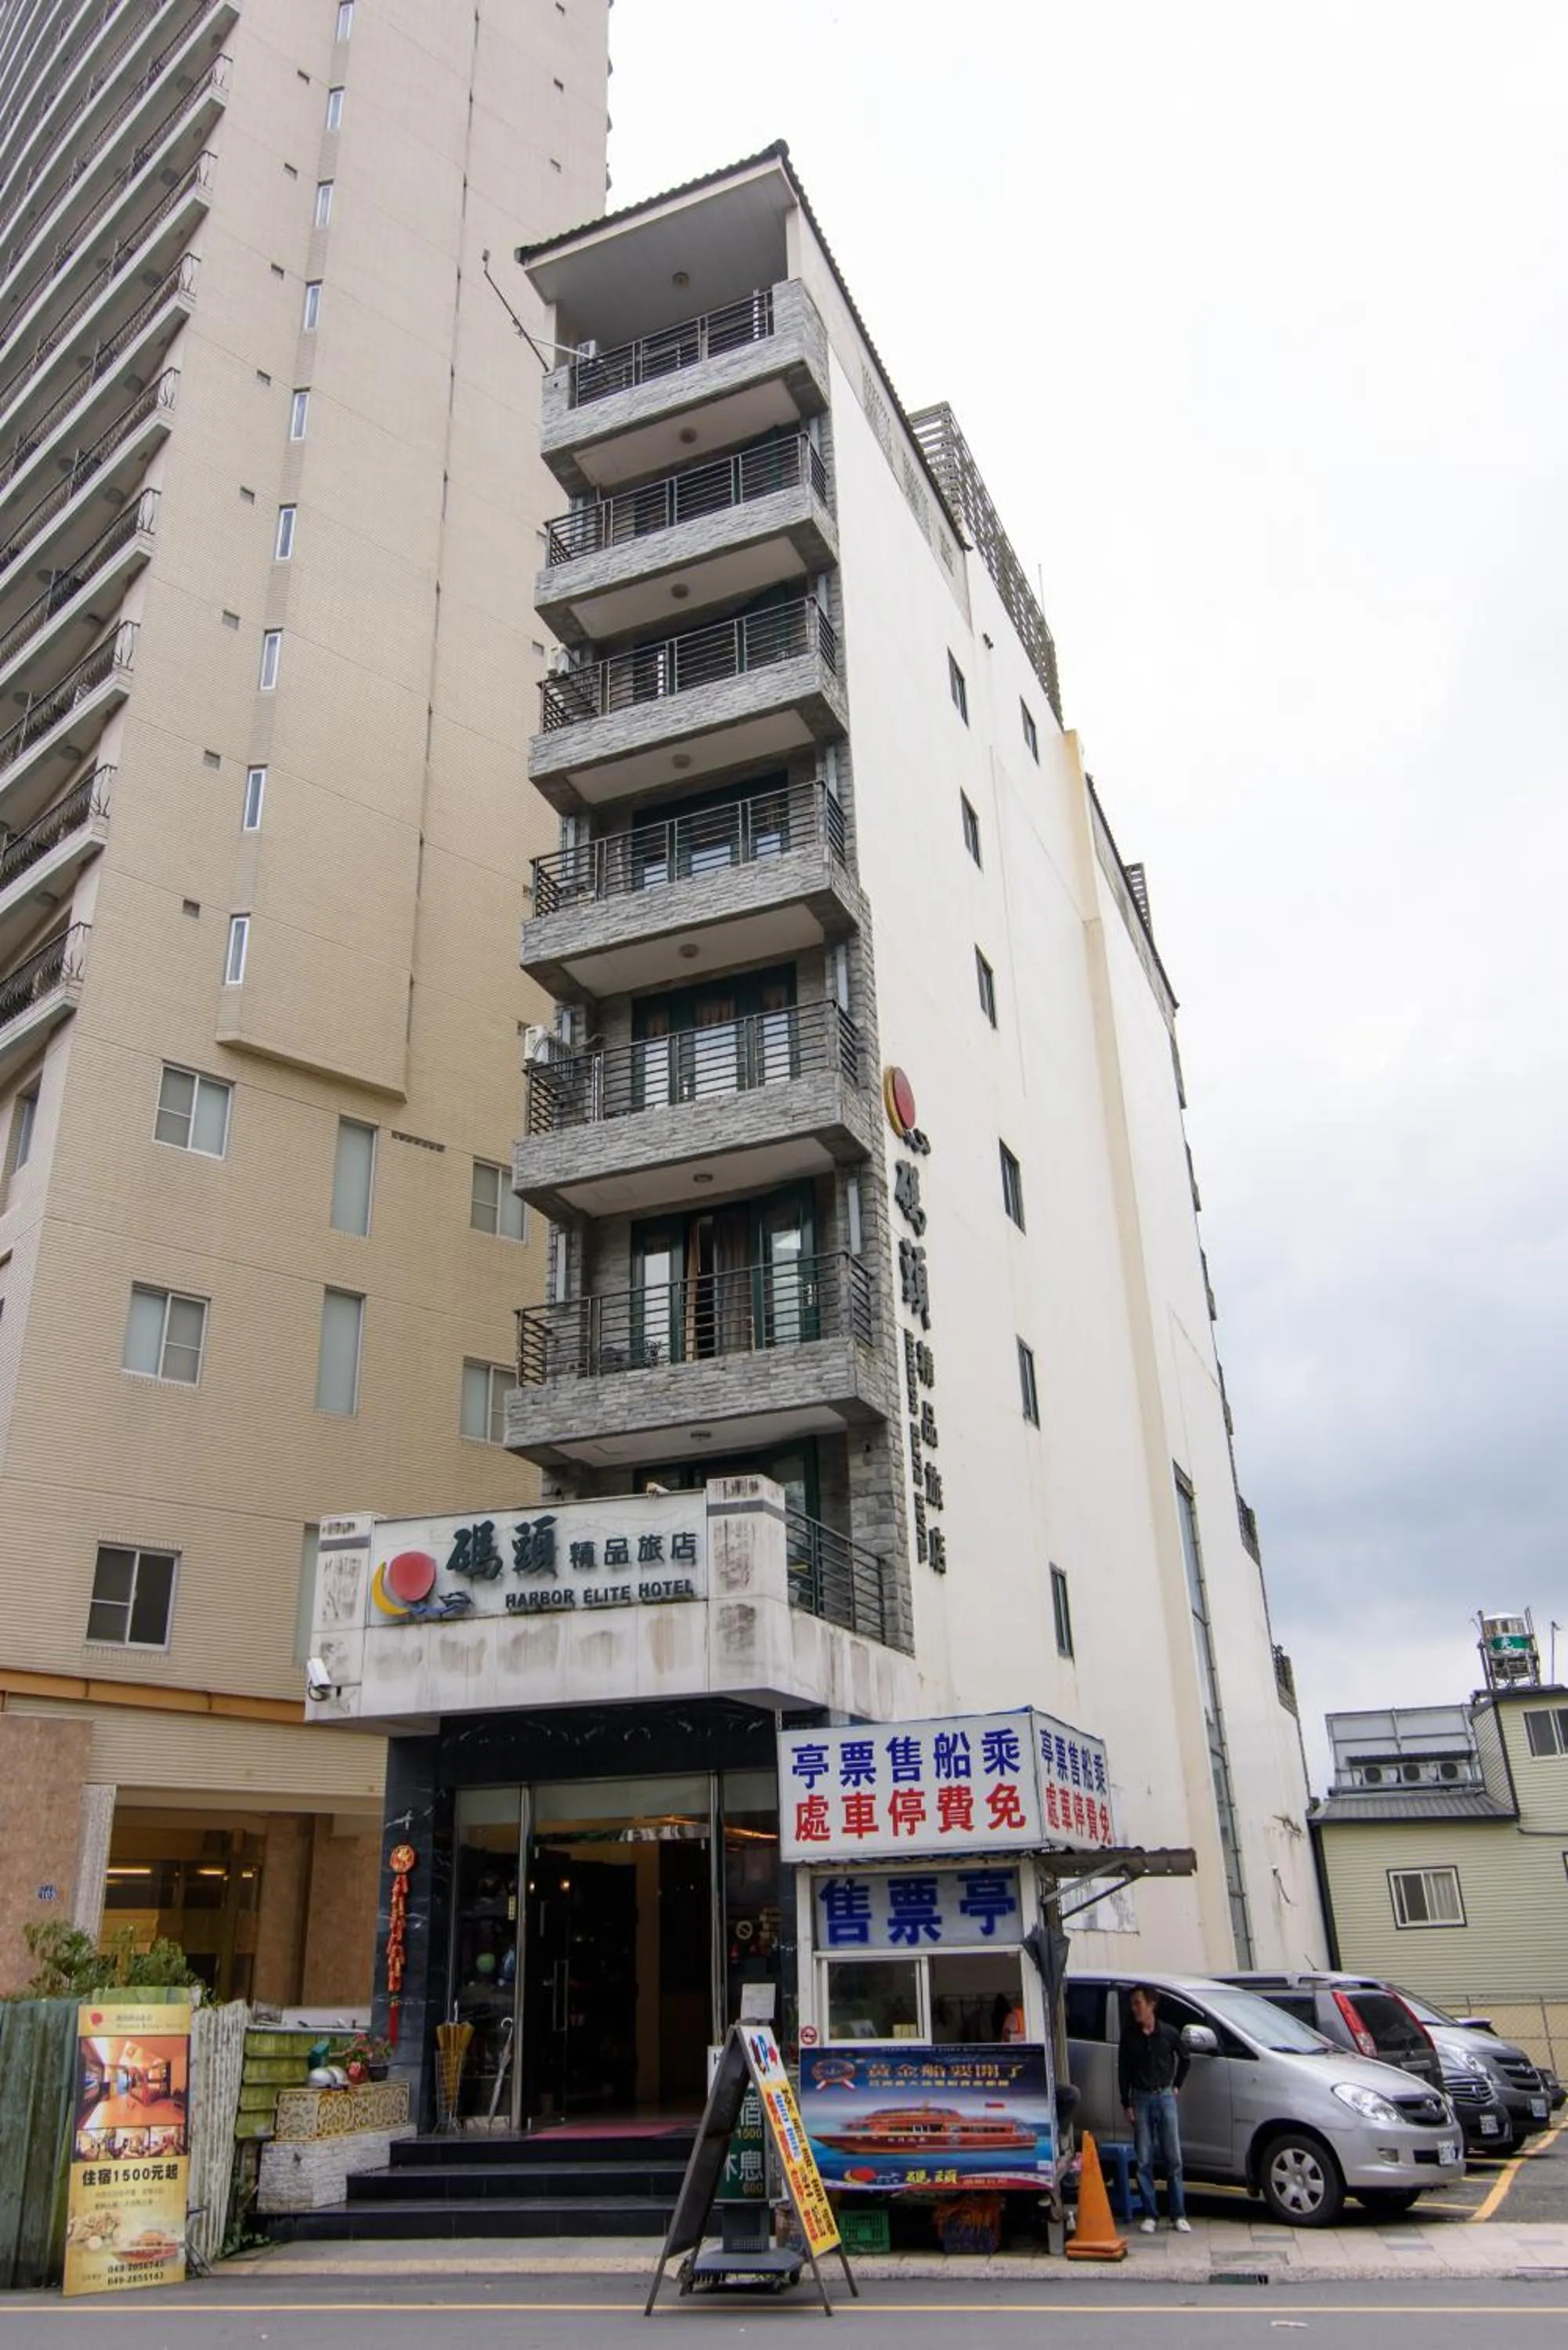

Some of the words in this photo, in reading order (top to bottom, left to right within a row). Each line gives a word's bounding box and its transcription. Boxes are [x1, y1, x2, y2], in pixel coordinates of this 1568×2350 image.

[505, 1588, 576, 1609] HARBOR
[583, 1585, 631, 1603] ELITE
[638, 1578, 694, 1597] HOTEL
[818, 1870, 1017, 1946] 售票亭
